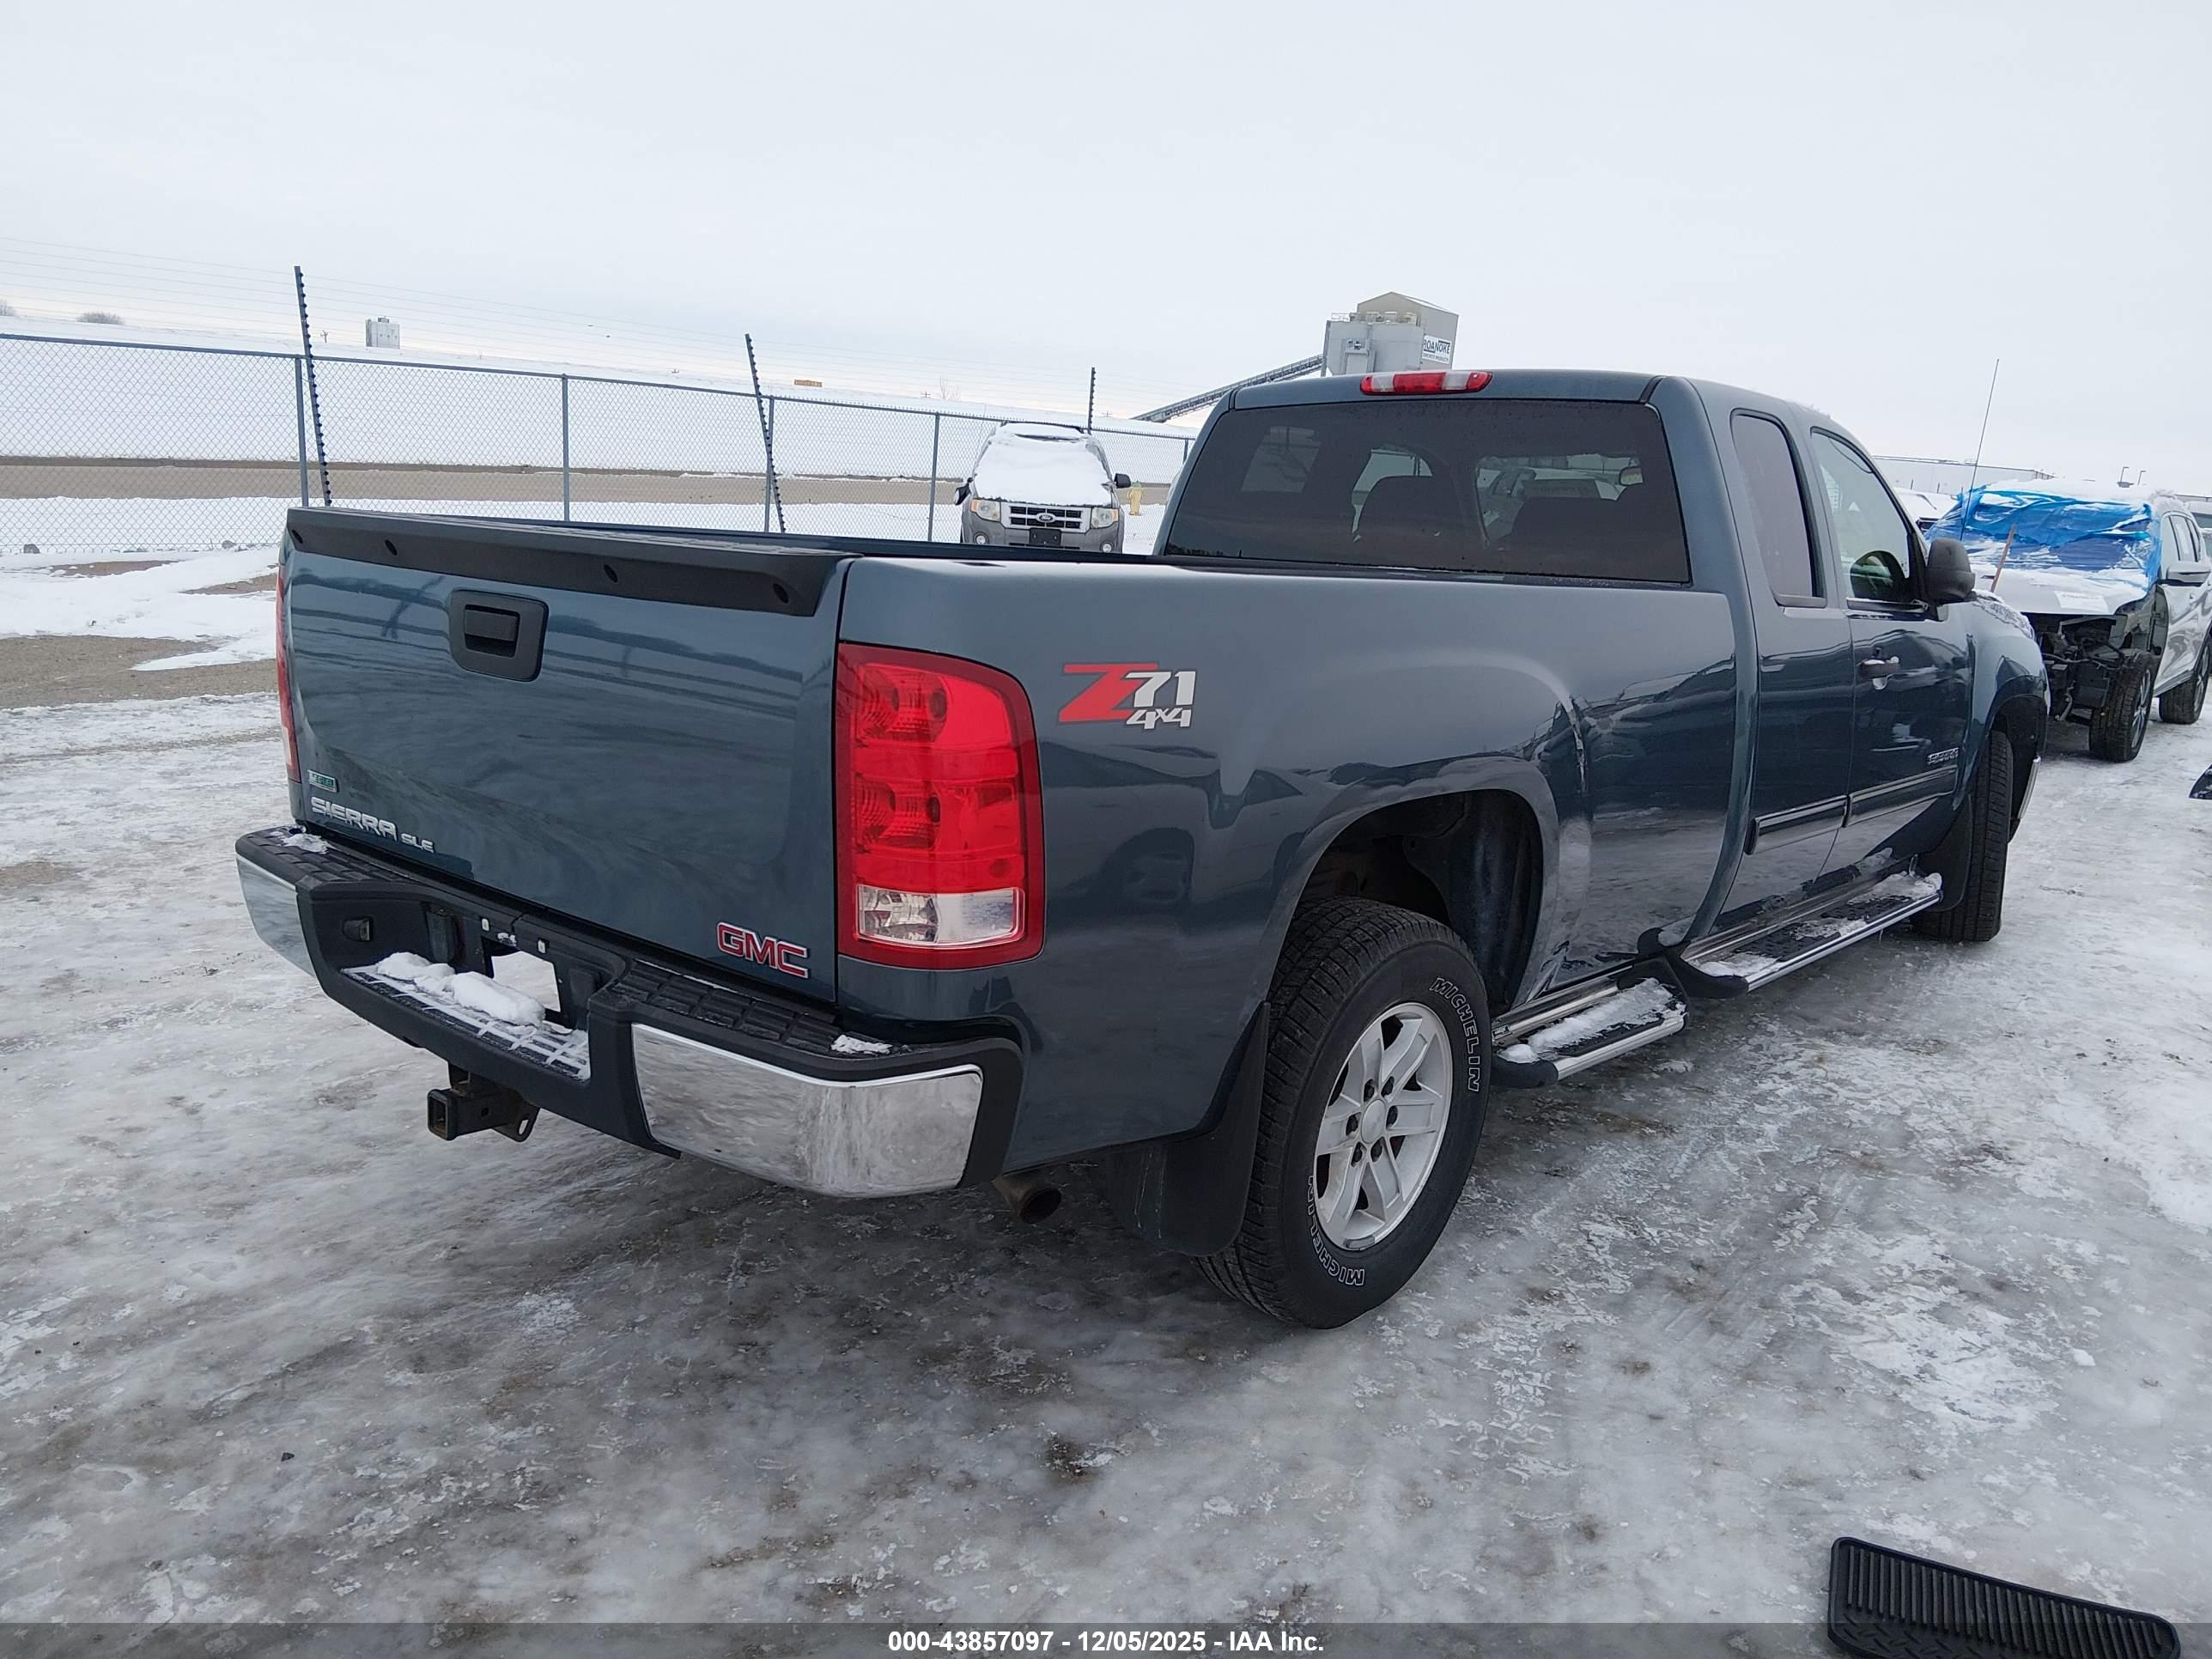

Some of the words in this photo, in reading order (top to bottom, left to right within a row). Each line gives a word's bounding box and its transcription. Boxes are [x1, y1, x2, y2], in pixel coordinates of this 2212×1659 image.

[1059, 663, 1196, 723] Z71
[310, 797, 397, 842] SIERRA
[400, 833, 434, 854] SLE
[717, 921, 809, 979] GMC
[1429, 977, 1480, 1092] MICHELIN
